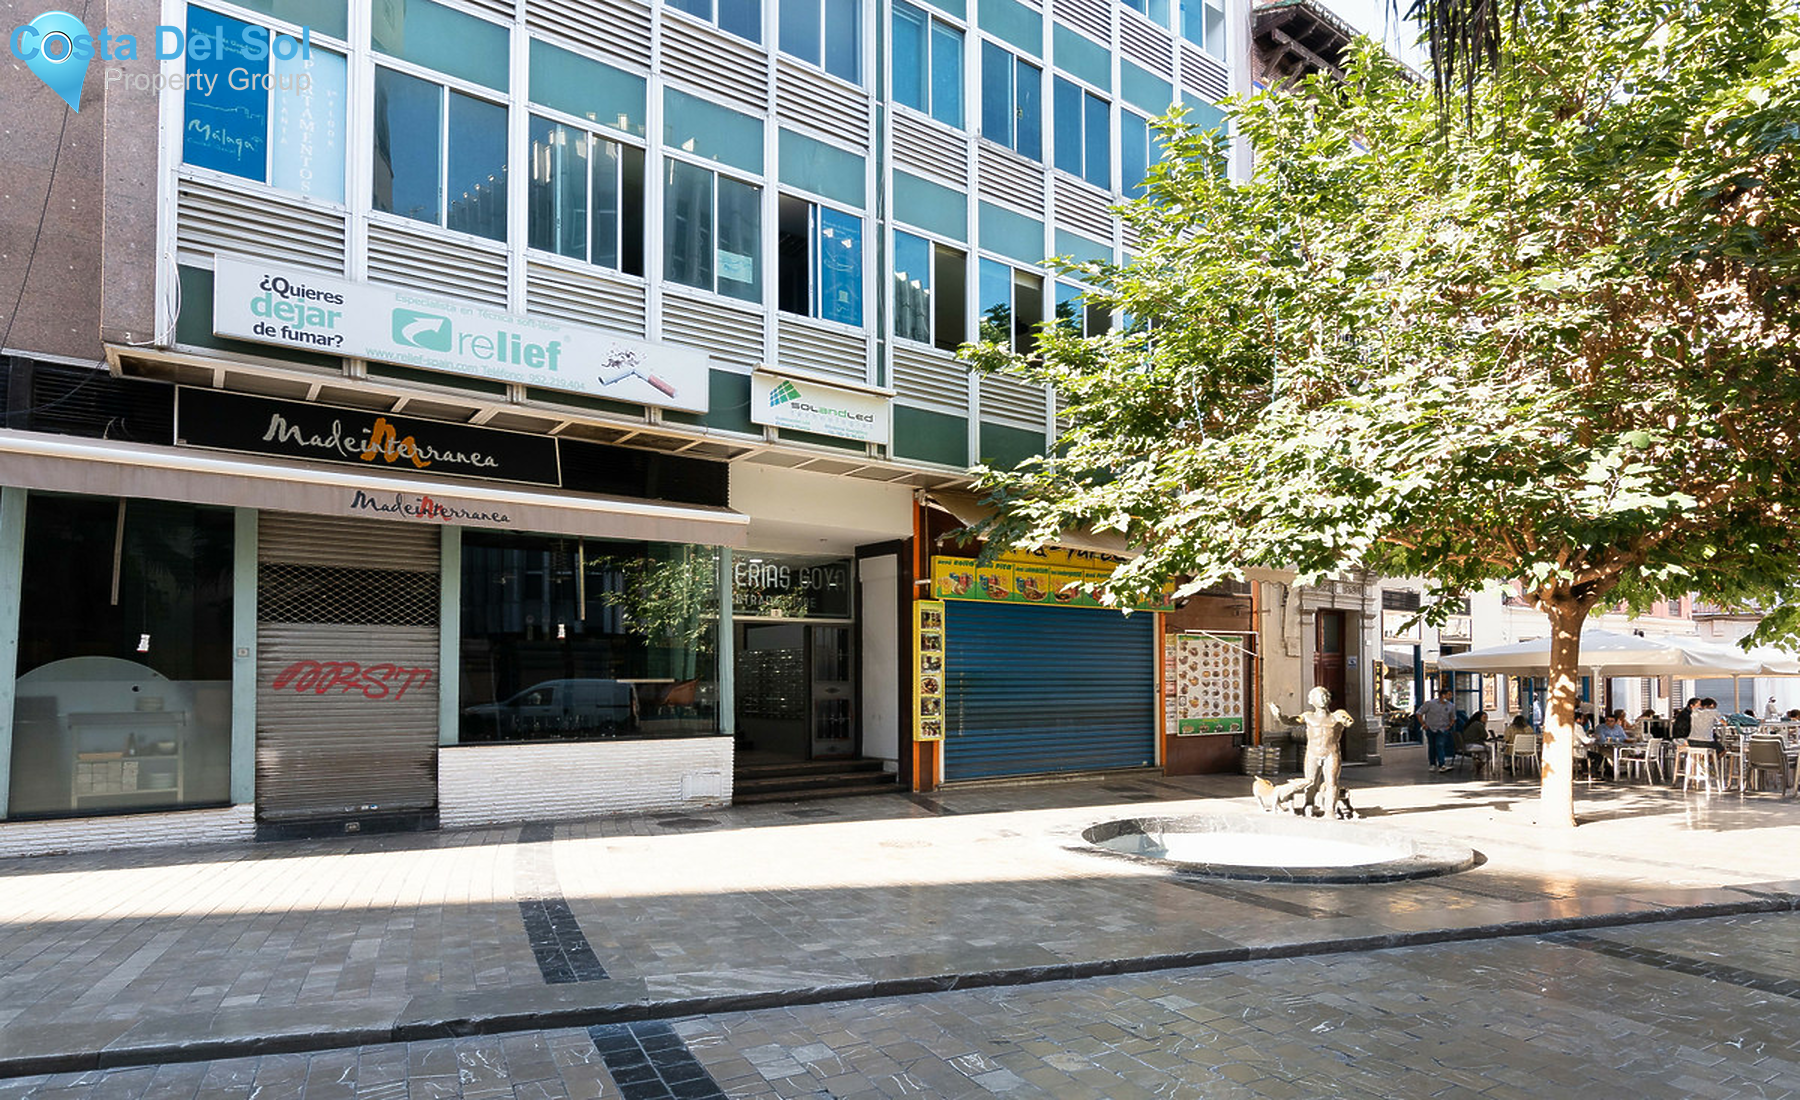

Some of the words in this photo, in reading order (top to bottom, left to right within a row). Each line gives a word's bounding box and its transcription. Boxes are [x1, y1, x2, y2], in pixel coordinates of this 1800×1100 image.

[188, 119, 255, 161] Málaga
[259, 274, 344, 305] ¿Quieres
[250, 292, 342, 329] dejar
[253, 321, 277, 338] de
[281, 325, 344, 348] fumar?
[459, 330, 562, 372] relief
[735, 562, 790, 590] ERIAS
[800, 567, 846, 591] GOYA
